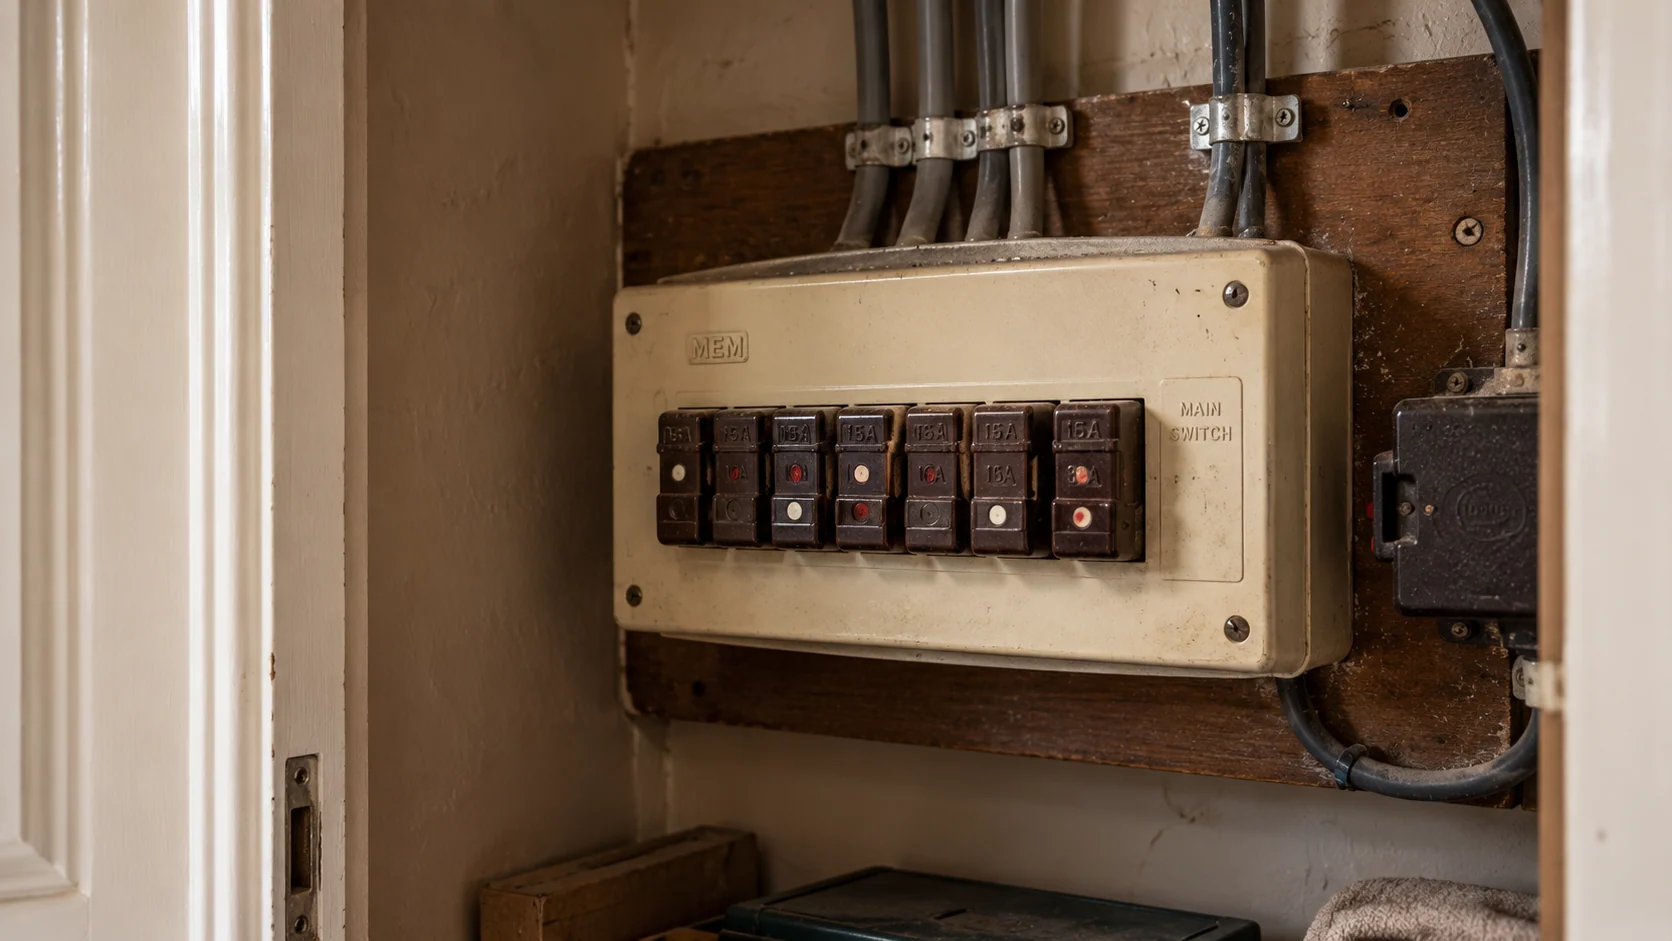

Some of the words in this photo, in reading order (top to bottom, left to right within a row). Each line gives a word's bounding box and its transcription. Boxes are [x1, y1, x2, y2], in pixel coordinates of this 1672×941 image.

[692, 336, 743, 359] MEM
[1180, 401, 1221, 417] MAIN
[846, 424, 878, 443] 15A
[985, 422, 1017, 441] 15A
[1169, 426, 1232, 442] SWITCH
